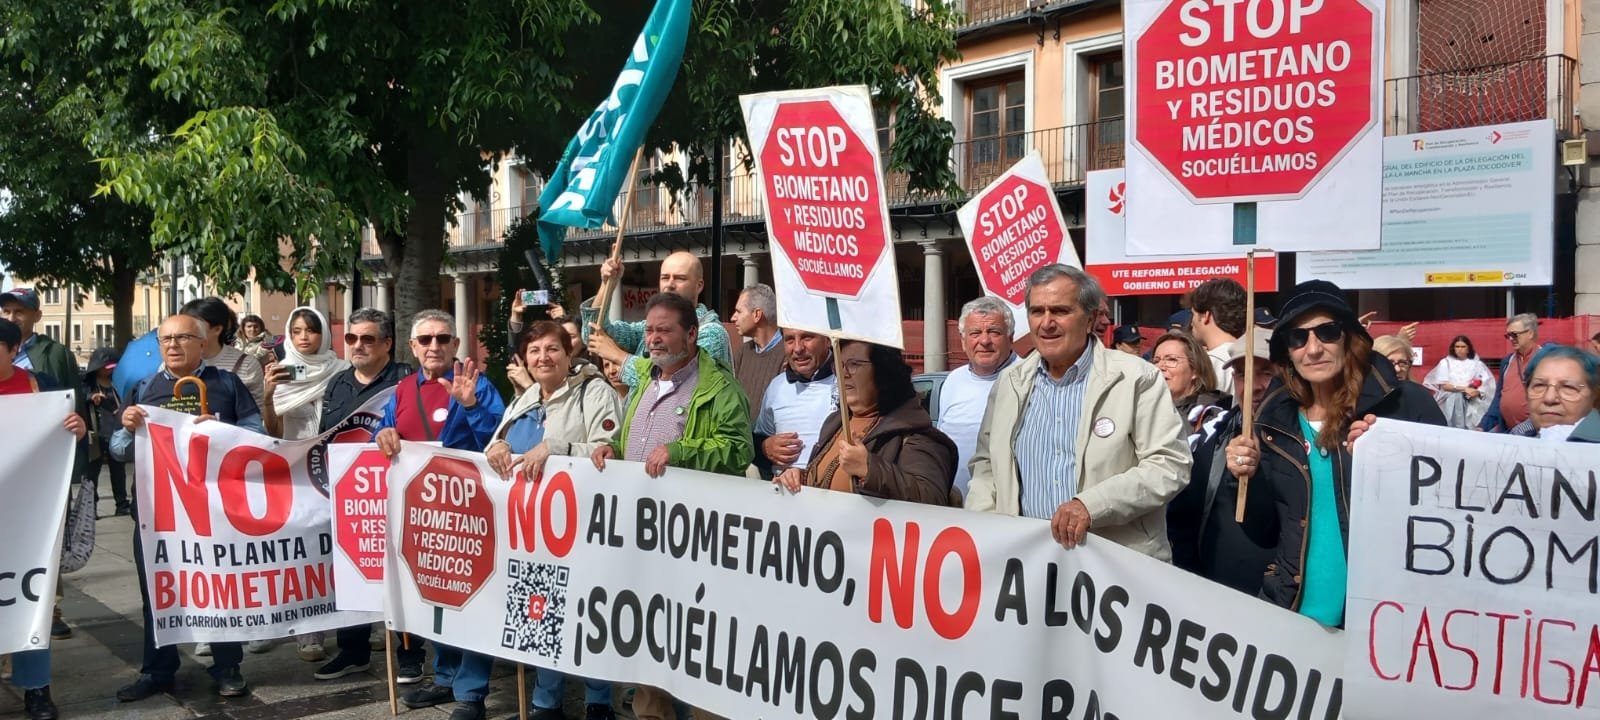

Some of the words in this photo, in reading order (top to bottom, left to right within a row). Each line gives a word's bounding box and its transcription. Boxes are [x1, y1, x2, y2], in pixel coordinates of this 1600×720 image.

[1178, 0, 1324, 47] STOP
[1155, 40, 1351, 90] BIOMETANO
[1167, 100, 1182, 120] Y
[1190, 79, 1336, 118] RESIDUOS
[776, 126, 847, 167] STOP
[1182, 116, 1314, 152] MÉDICOS
[1182, 152, 1317, 178] SOCUÉLLAMOS
[1415, 160, 1443, 169] EDIFICIO
[773, 175, 869, 202] BIOMETANO
[784, 207, 792, 224] Y
[794, 204, 865, 229] RESIDUOS
[980, 184, 1028, 237] STOP
[794, 228, 859, 256] MÉDICOS
[980, 204, 1047, 262] BIOMETANO
[990, 263, 998, 274] Y
[997, 225, 1049, 270] RESIDUOS
[798, 257, 864, 279] SOCUÉLLAMOS
[1001, 245, 1047, 286] MÉDICOS
[1112, 269, 1129, 278] UTE
[1132, 267, 1175, 278] REFORMA
[1177, 264, 1239, 276] DELEGACIÓN
[1123, 280, 1170, 290] GOBIERNO
[1173, 280, 1185, 289] EN
[311, 449, 322, 475] STOP
[148, 422, 294, 537] NO
[421, 472, 477, 508] STOP
[1410, 455, 1598, 522] PLAN
[350, 521, 358, 534] Y
[410, 506, 488, 537] BIOMETANO
[154, 539, 168, 564] A
[181, 540, 204, 566] LA
[213, 536, 307, 567] PLANTA
[413, 532, 420, 546] Y
[421, 531, 483, 557] RESIDUOS
[417, 550, 473, 577] MÉDICOS
[508, 470, 578, 558] NO
[586, 493, 624, 548] AL
[635, 497, 856, 607] BIOMETANO,
[867, 518, 982, 640] NO
[994, 557, 1028, 626] A
[1044, 561, 1130, 654] LOS
[417, 572, 472, 595] SOCUÉLLAMOS
[157, 616, 166, 631] NI
[169, 615, 183, 628] EN
[186, 613, 227, 629] CARRIÓN
[230, 615, 243, 628] DE
[245, 614, 269, 627] CVA.
[271, 611, 282, 624] NI
[285, 608, 298, 622] EN
[573, 582, 877, 720] ¡SOCUÉLLAMOS
[893, 657, 1023, 720] DICE
